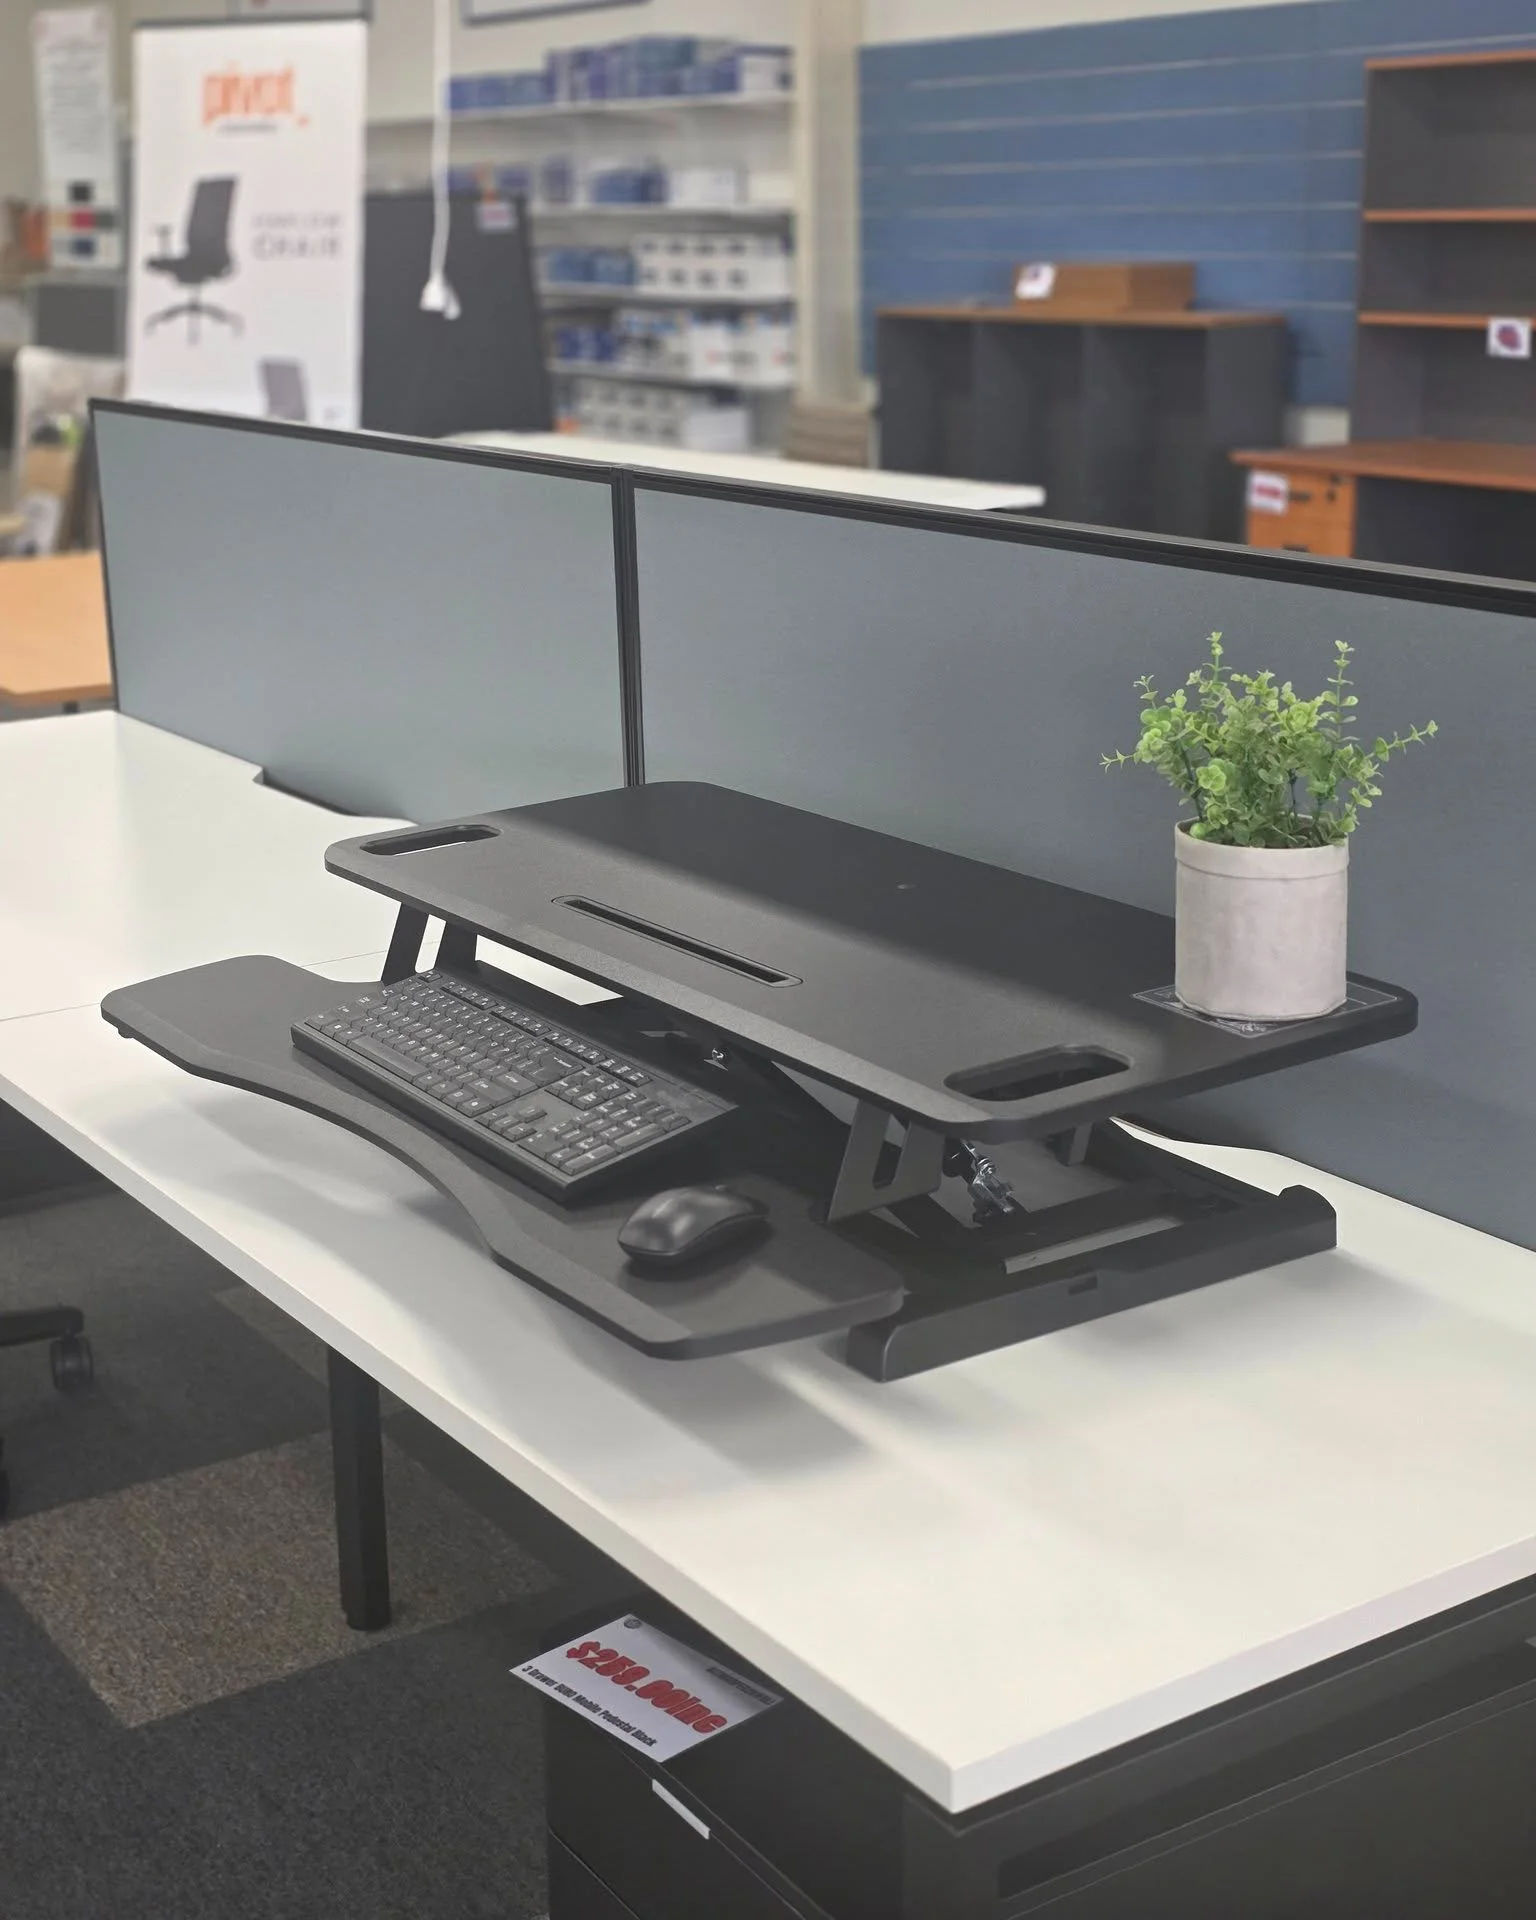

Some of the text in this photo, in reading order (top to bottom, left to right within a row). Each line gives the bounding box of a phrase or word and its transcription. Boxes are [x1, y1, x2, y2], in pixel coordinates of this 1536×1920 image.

[521, 1665, 530, 1674] 3
[528, 1669, 558, 1687] Drawer
[572, 1694, 603, 1714] Mobile
[598, 1709, 636, 1734] Pedestal
[631, 1729, 658, 1747] Black
